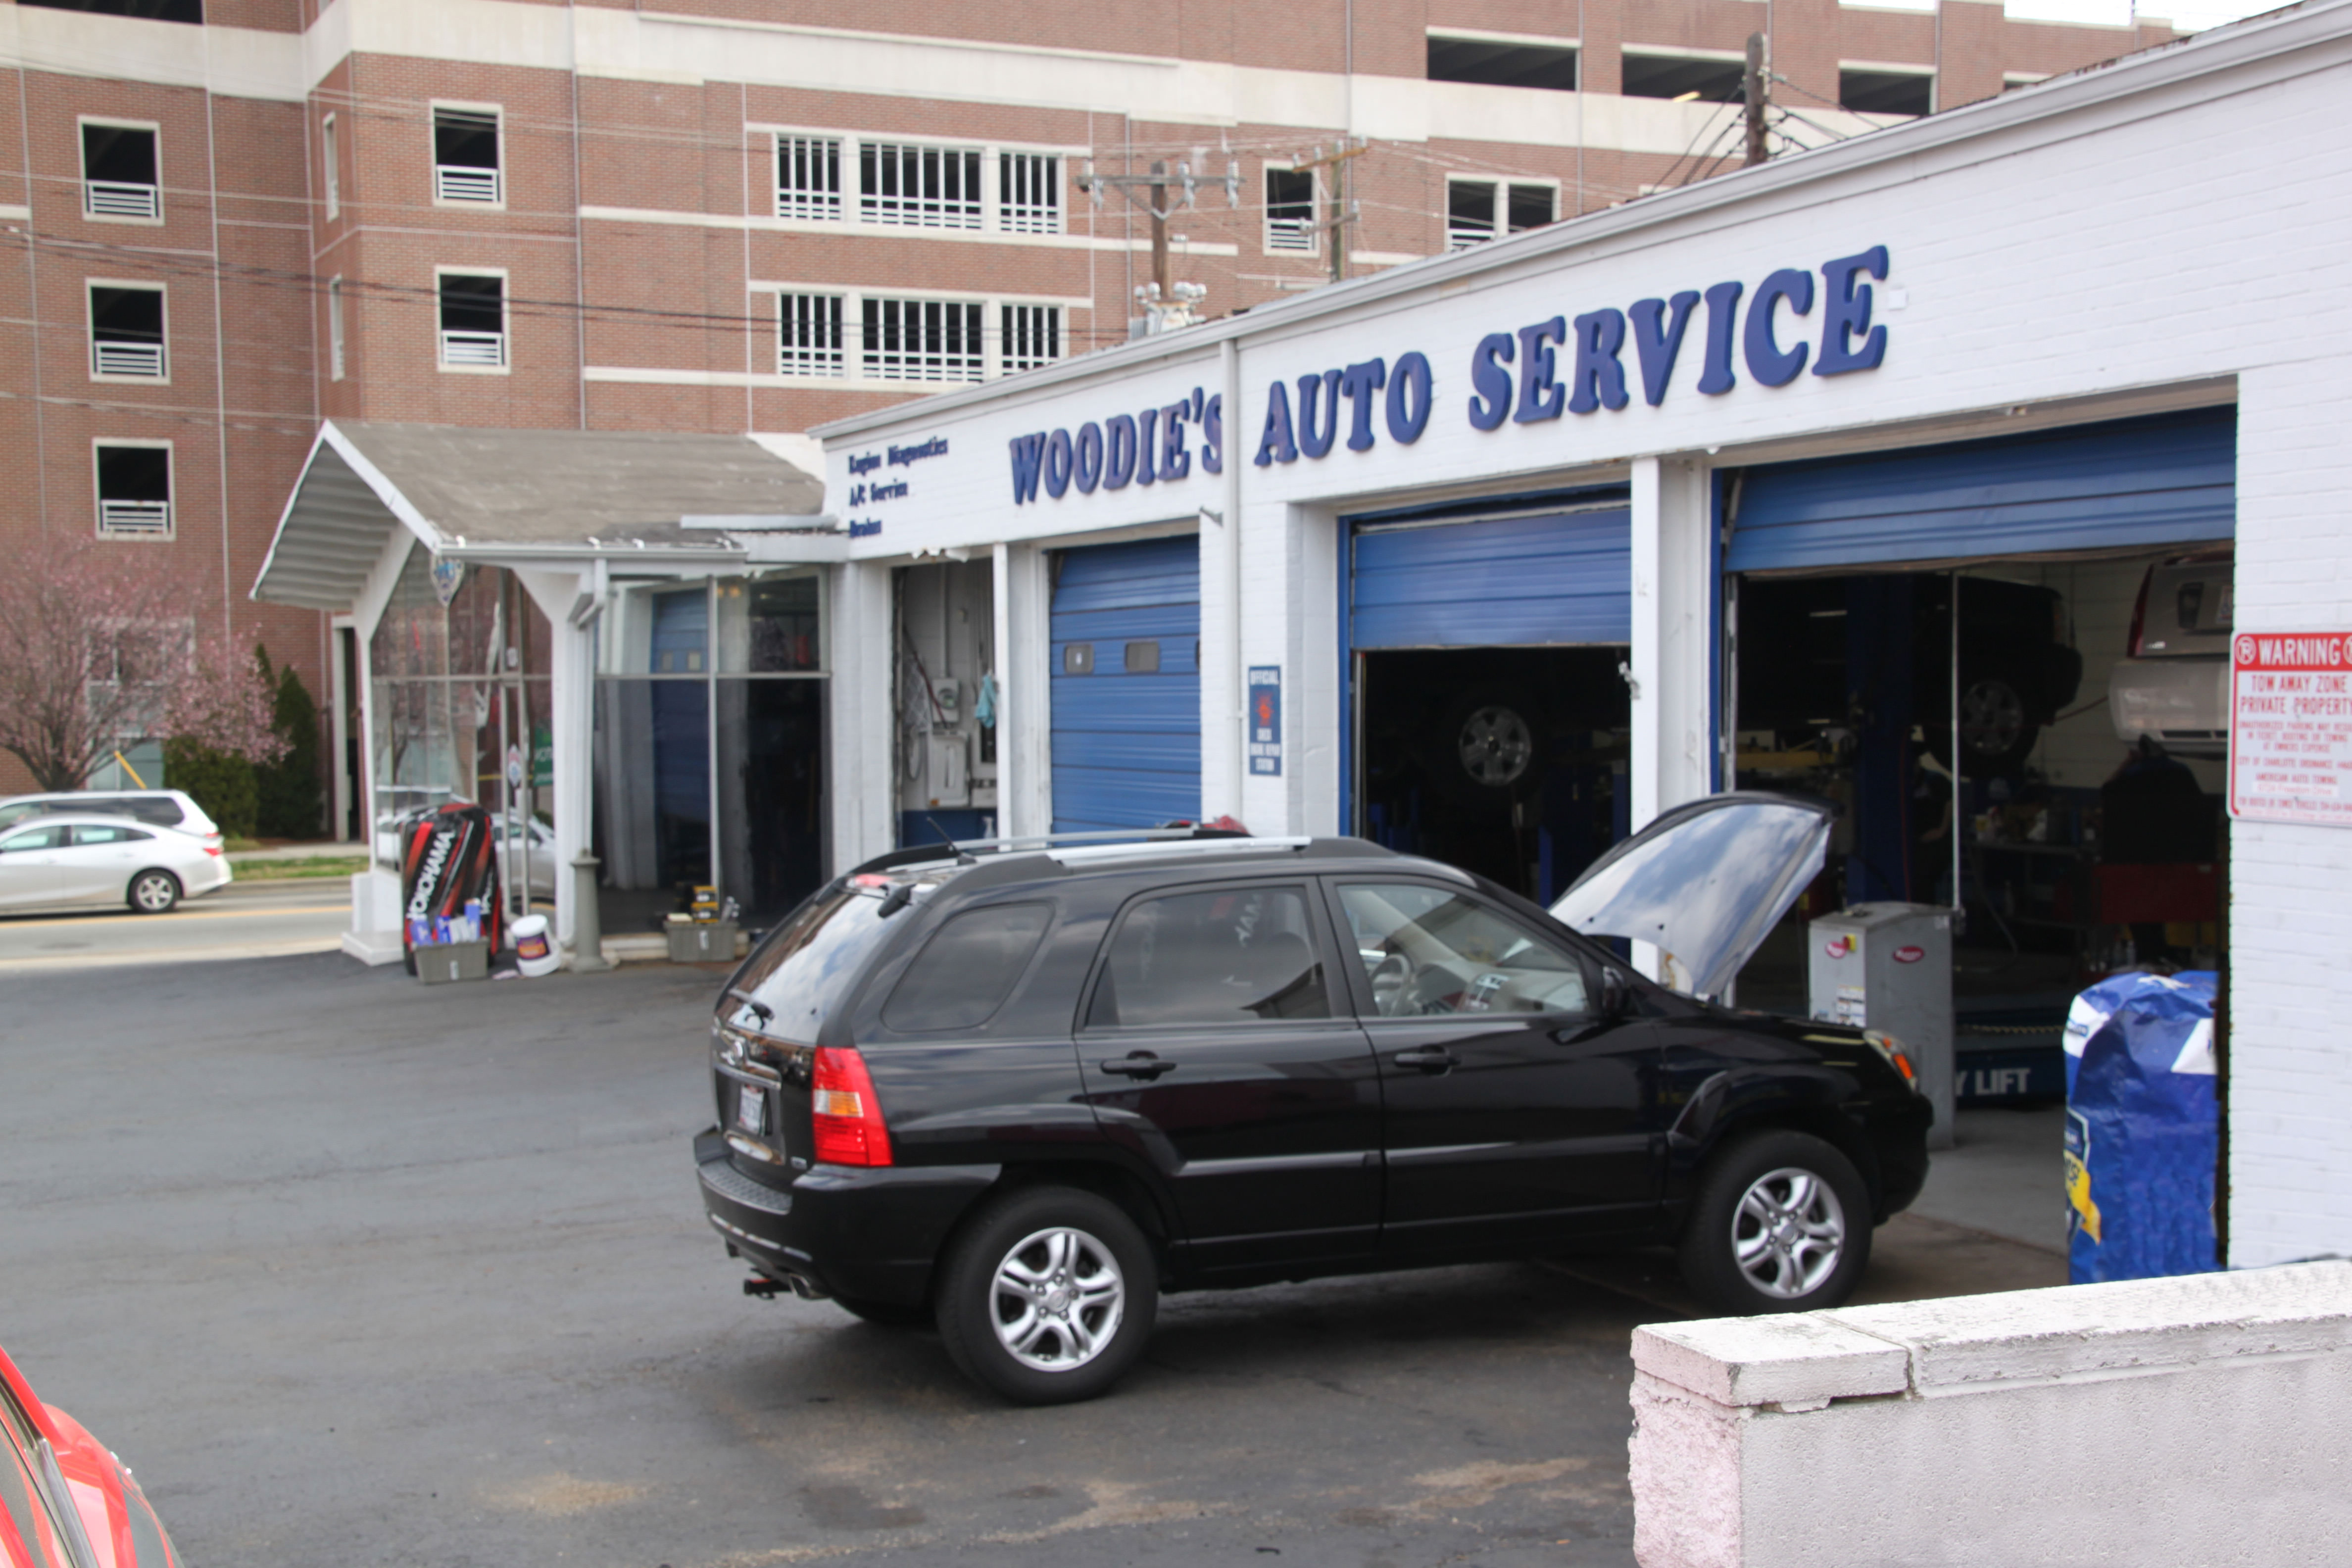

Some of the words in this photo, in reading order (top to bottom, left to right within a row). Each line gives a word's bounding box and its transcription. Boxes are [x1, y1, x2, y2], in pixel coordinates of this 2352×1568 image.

[1009, 386, 1222, 505] WOODIE'S
[1254, 351, 1432, 467] AUTO
[1469, 245, 1889, 432] SERVICE
[870, 478, 908, 502] Service
[2258, 638, 2341, 666] WARNING
[2251, 675, 2275, 692] TOW
[2279, 675, 2310, 692] AWAY
[2316, 675, 2347, 693] ZONE
[2240, 696, 2286, 714] PRIVATE
[405, 831, 456, 920] YOKOHAMA
[1975, 1068, 2032, 1096] LIFT
